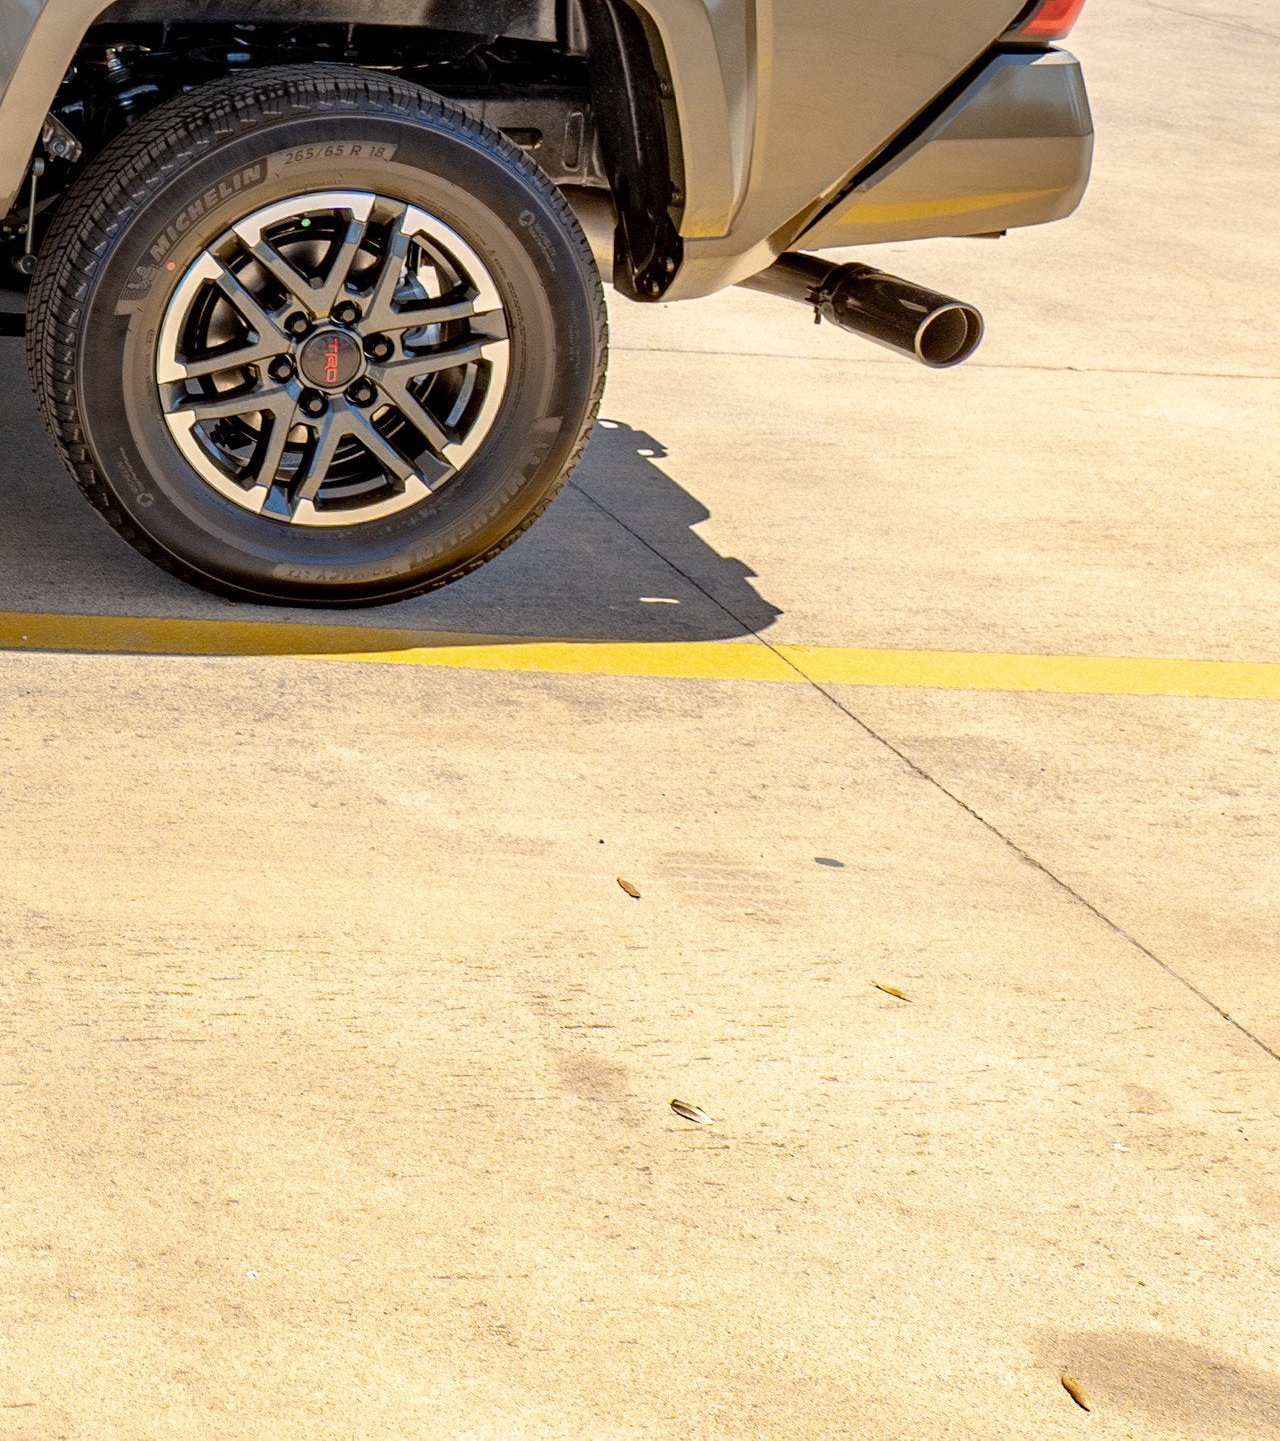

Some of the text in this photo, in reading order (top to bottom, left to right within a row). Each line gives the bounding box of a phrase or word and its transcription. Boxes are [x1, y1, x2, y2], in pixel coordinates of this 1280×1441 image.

[284, 145, 386, 165] 265/65 R 18
[149, 164, 261, 260] MICHELIN
[324, 338, 338, 383] TRD
[415, 469, 527, 563] MICHELIN
